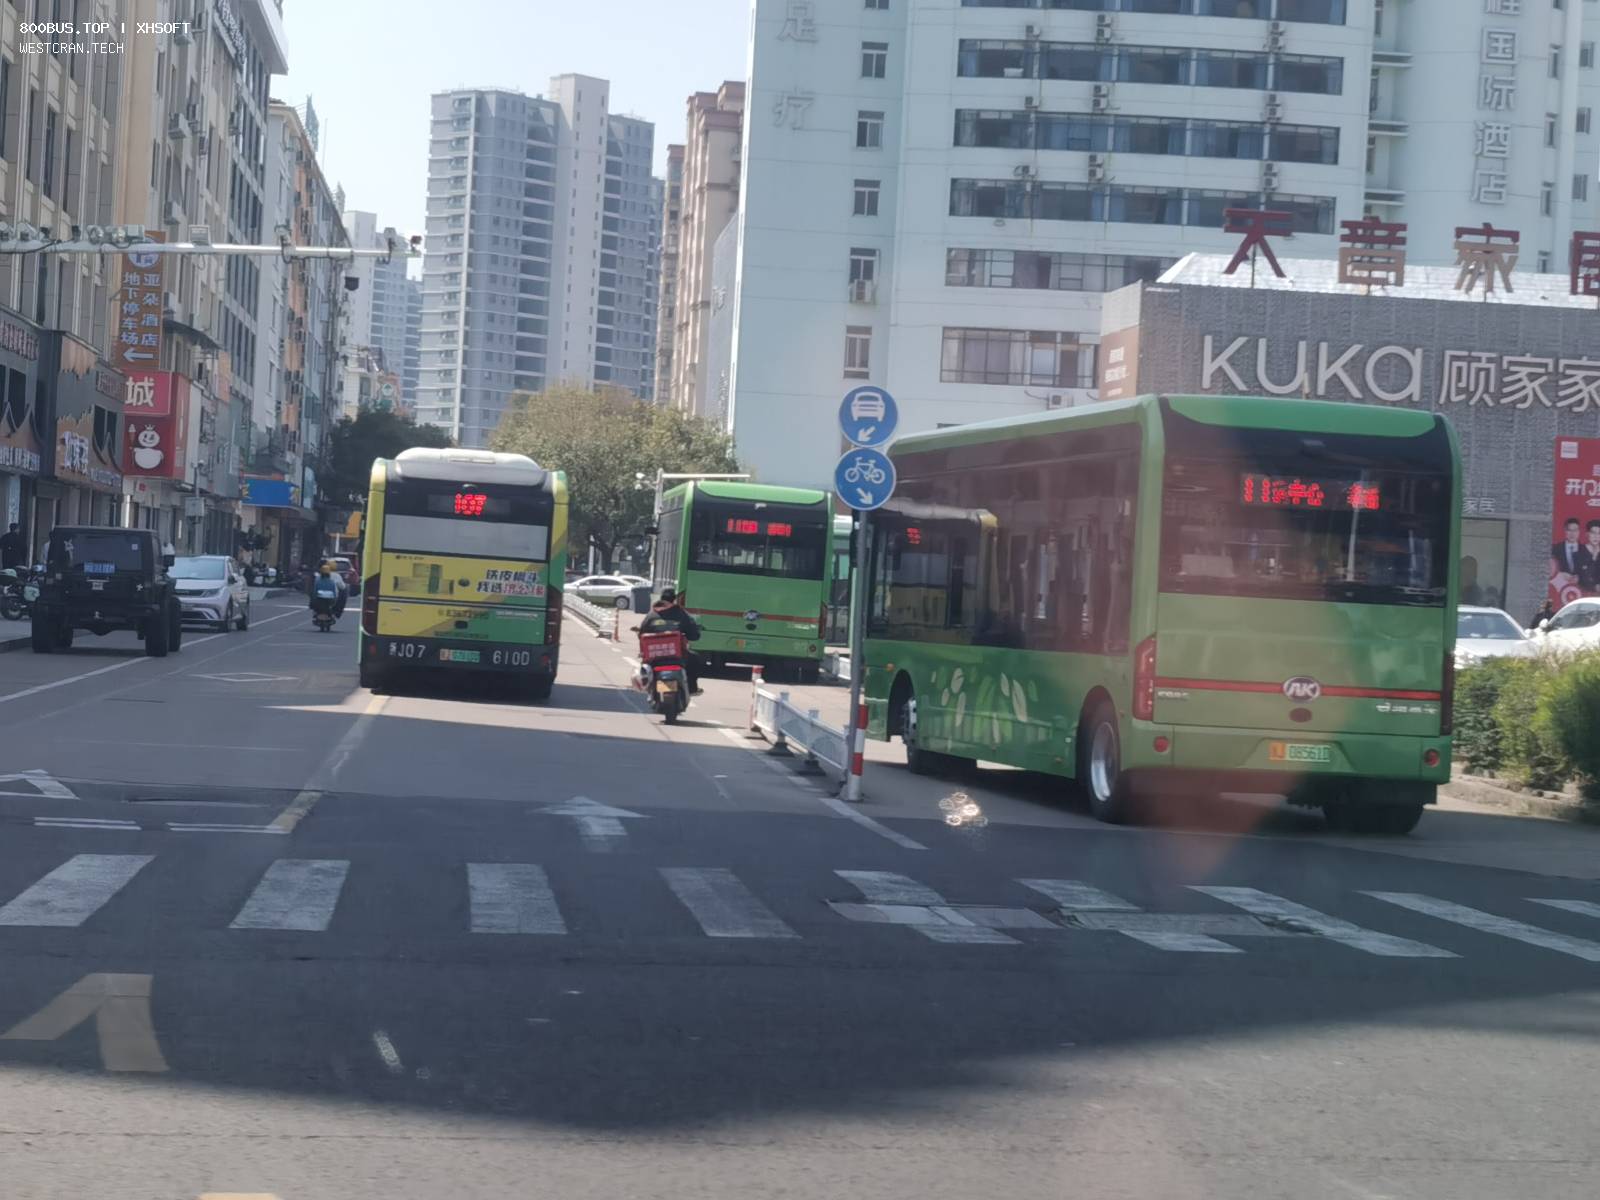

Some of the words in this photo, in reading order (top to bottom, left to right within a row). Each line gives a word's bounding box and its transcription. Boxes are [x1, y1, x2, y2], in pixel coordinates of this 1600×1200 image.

[120, 271, 141, 346] 地下停车场
[124, 376, 156, 408] 城
[1564, 478, 1600, 497] 开门
[1462, 497, 1496, 514] 家居
